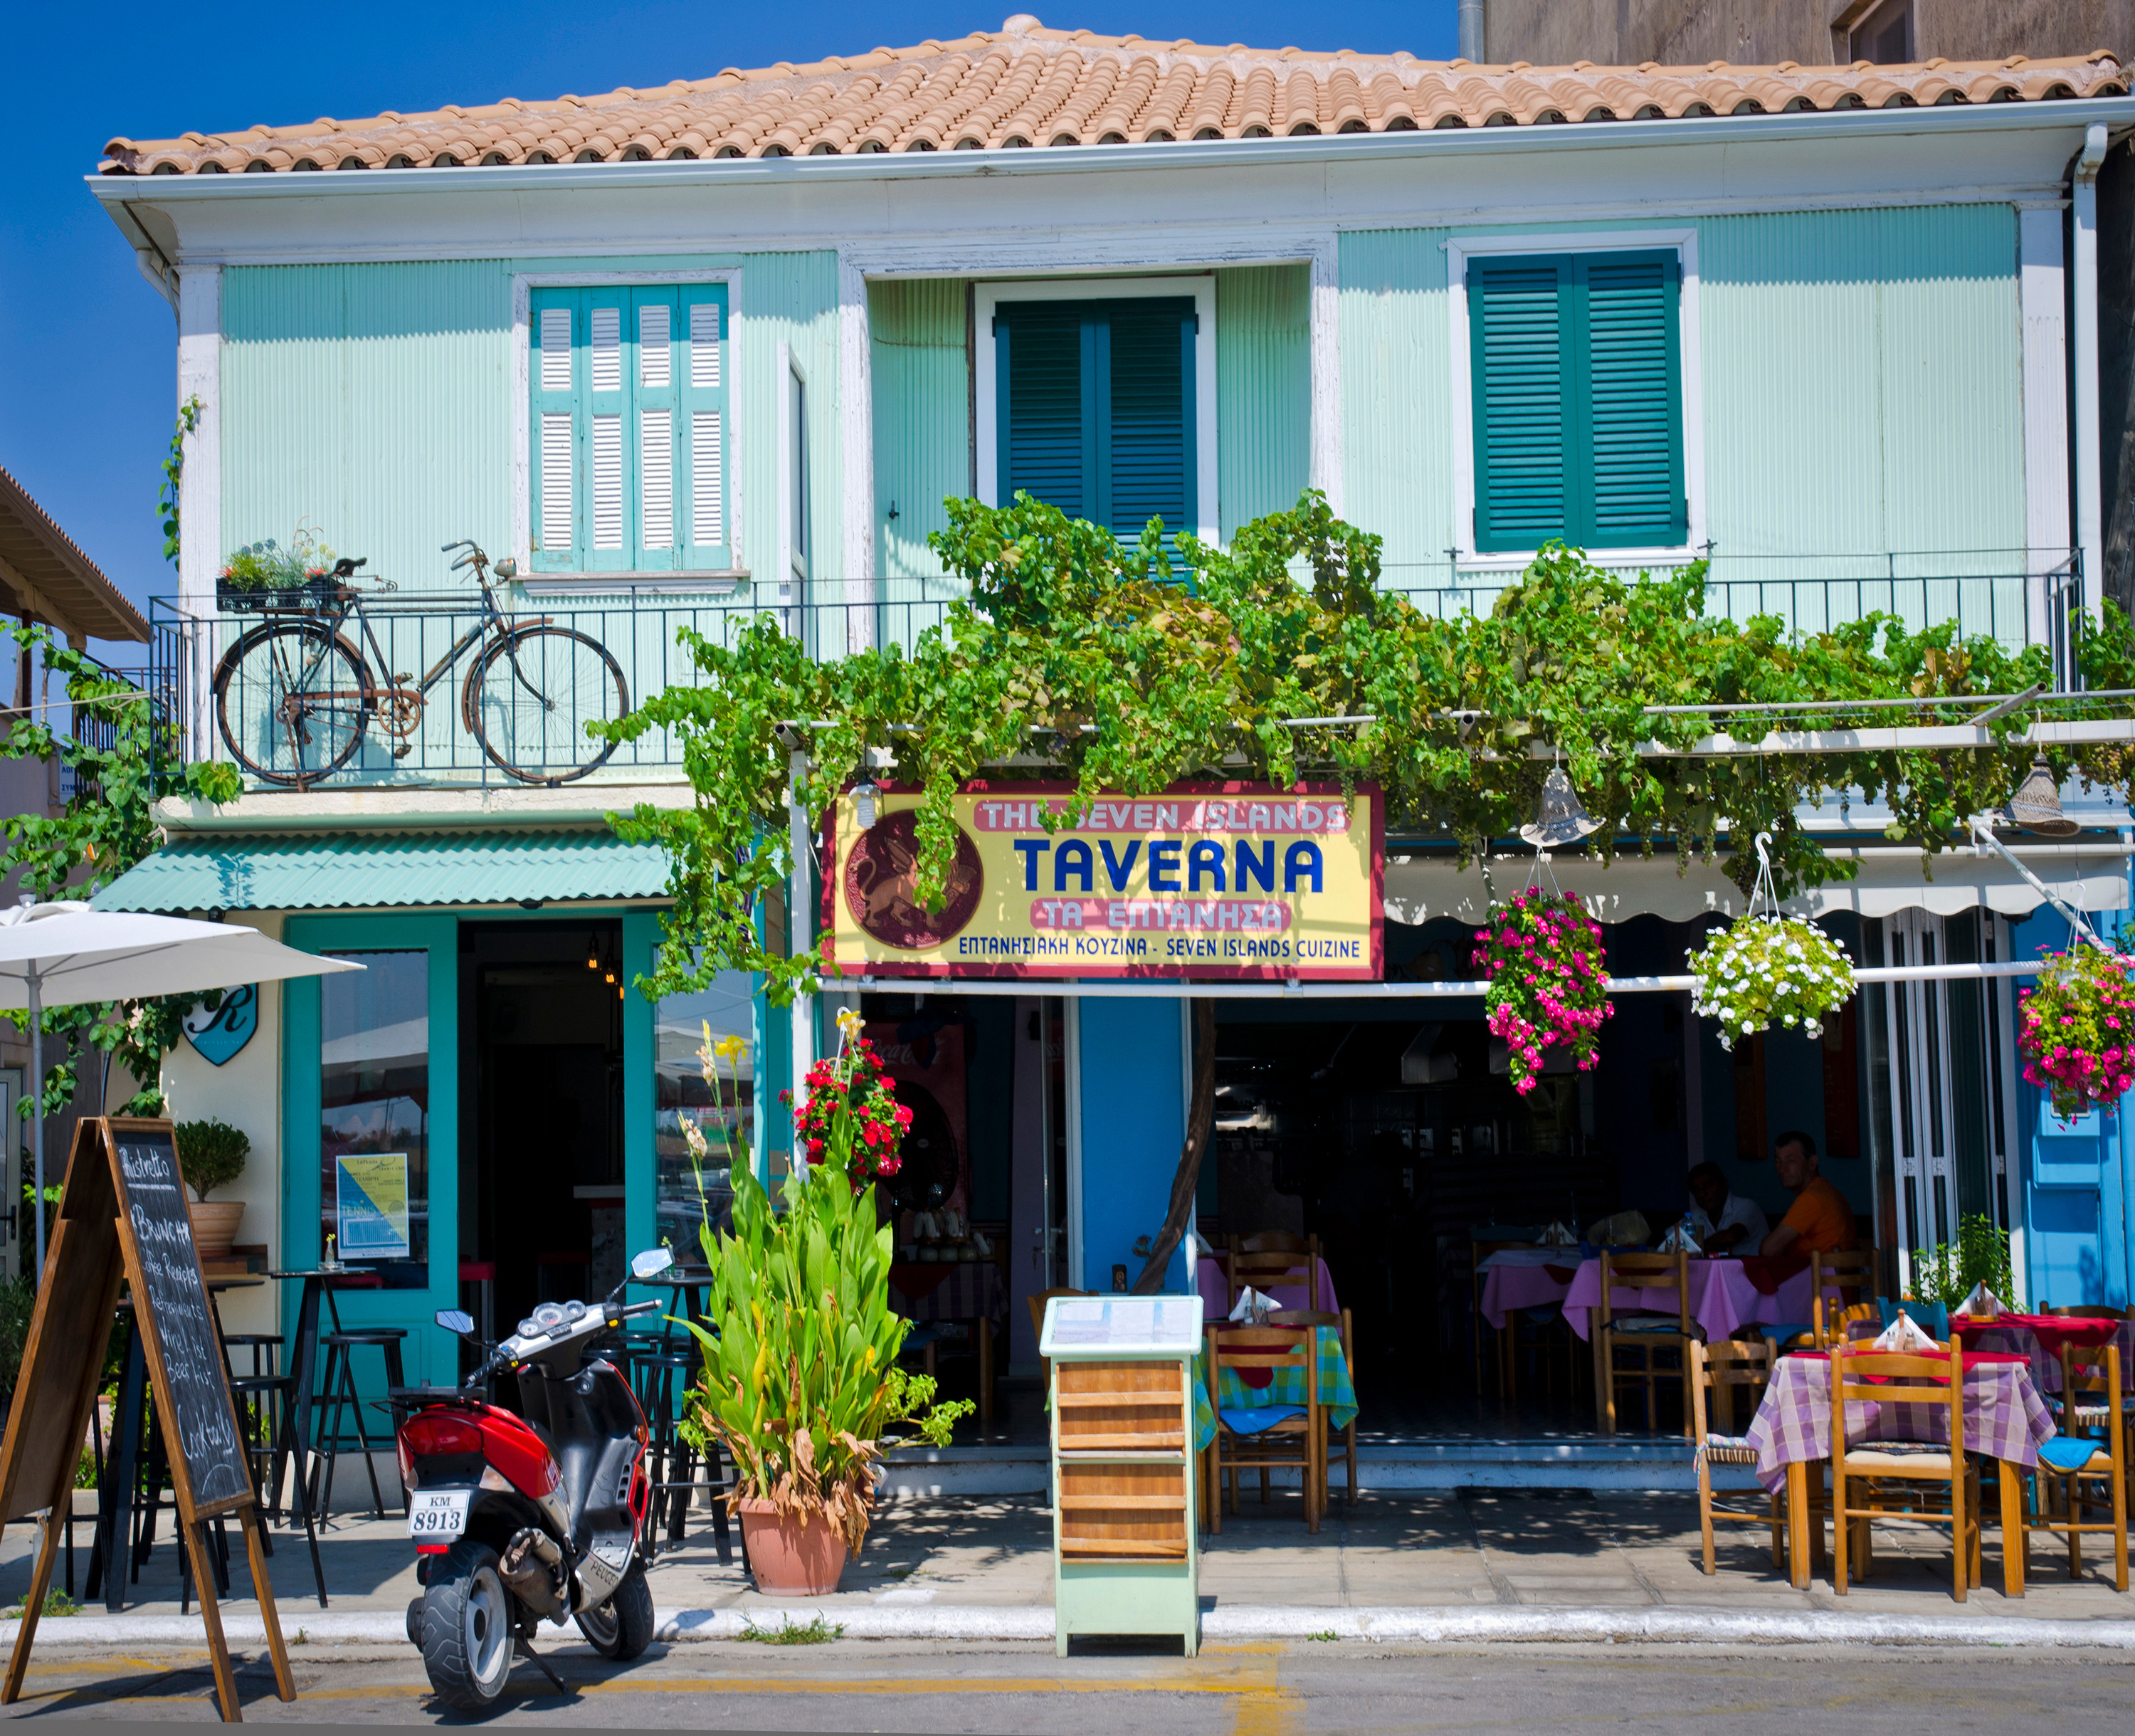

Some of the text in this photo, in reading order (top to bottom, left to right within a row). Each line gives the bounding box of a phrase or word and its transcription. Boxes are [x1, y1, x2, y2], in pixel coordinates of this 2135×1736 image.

[1195, 804, 1346, 830] ISLANDS
[1013, 838, 1324, 893] TAVERNA
[1042, 902, 1282, 928] ΤΑ ΕΠΤΑΝΗΣΑ
[959, 937, 1069, 955] ΕΠΤΑΝΗΣΙΑΚΗ
[1075, 937, 1147, 956] ΚΟΥΖΙΝΑ
[1166, 938, 1217, 957] SEVEN
[1223, 939, 1290, 958] ISLANDS
[1296, 940, 1360, 959] CUIZINE
[342, 1206, 376, 1216] TENNIS
[163, 1353, 190, 1384] Beer
[430, 1496, 451, 1507] KM
[413, 1511, 460, 1530] 8913
